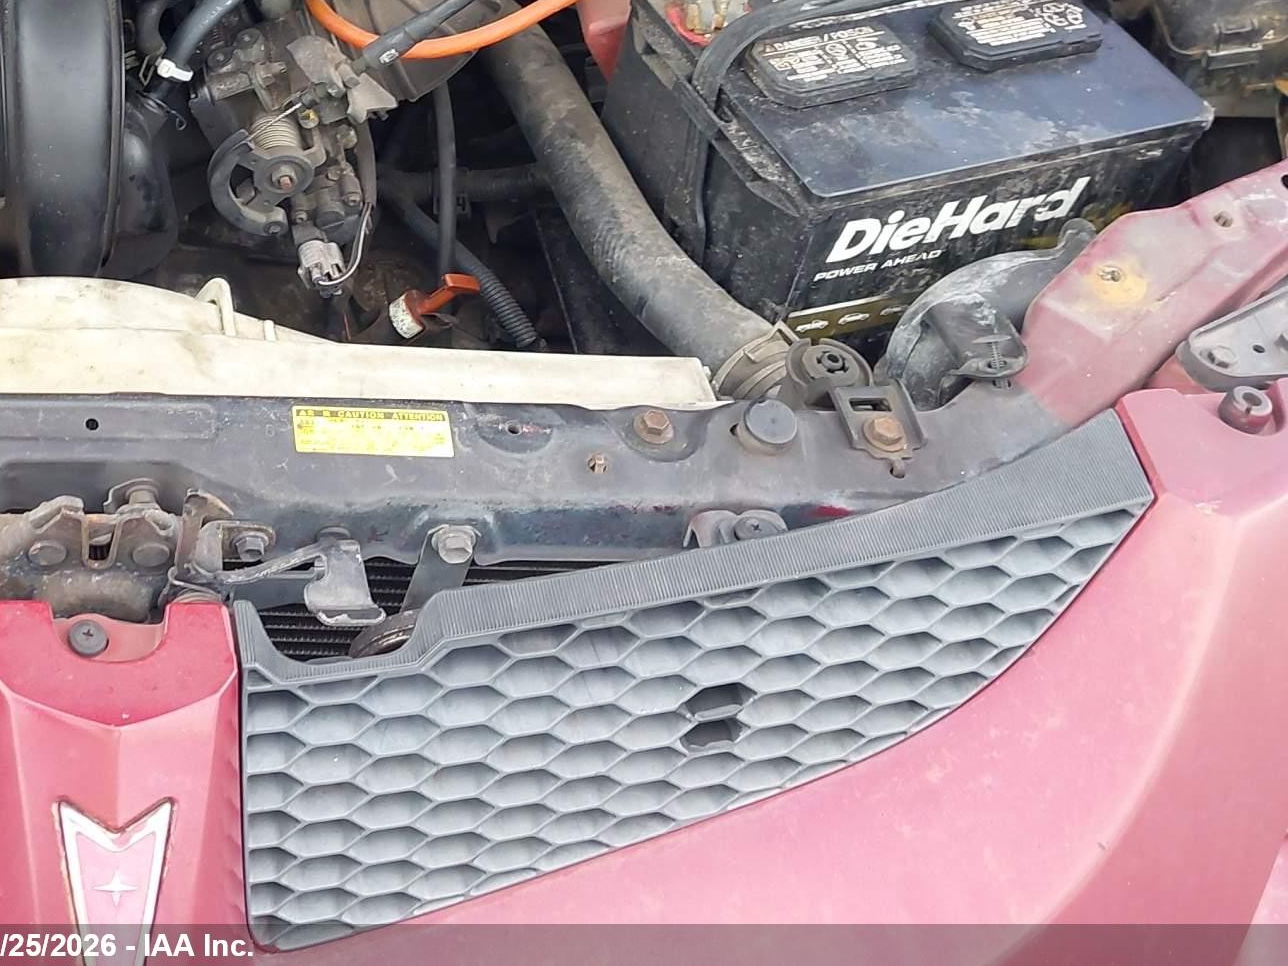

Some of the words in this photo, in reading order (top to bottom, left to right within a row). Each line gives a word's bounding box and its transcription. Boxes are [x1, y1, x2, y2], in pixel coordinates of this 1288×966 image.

[825, 176, 1092, 263] DieHard
[813, 262, 878, 283] POWER
[879, 249, 942, 270] AHEAD
[337, 409, 385, 419] CAUTION
[391, 411, 443, 422] ATTENTION
